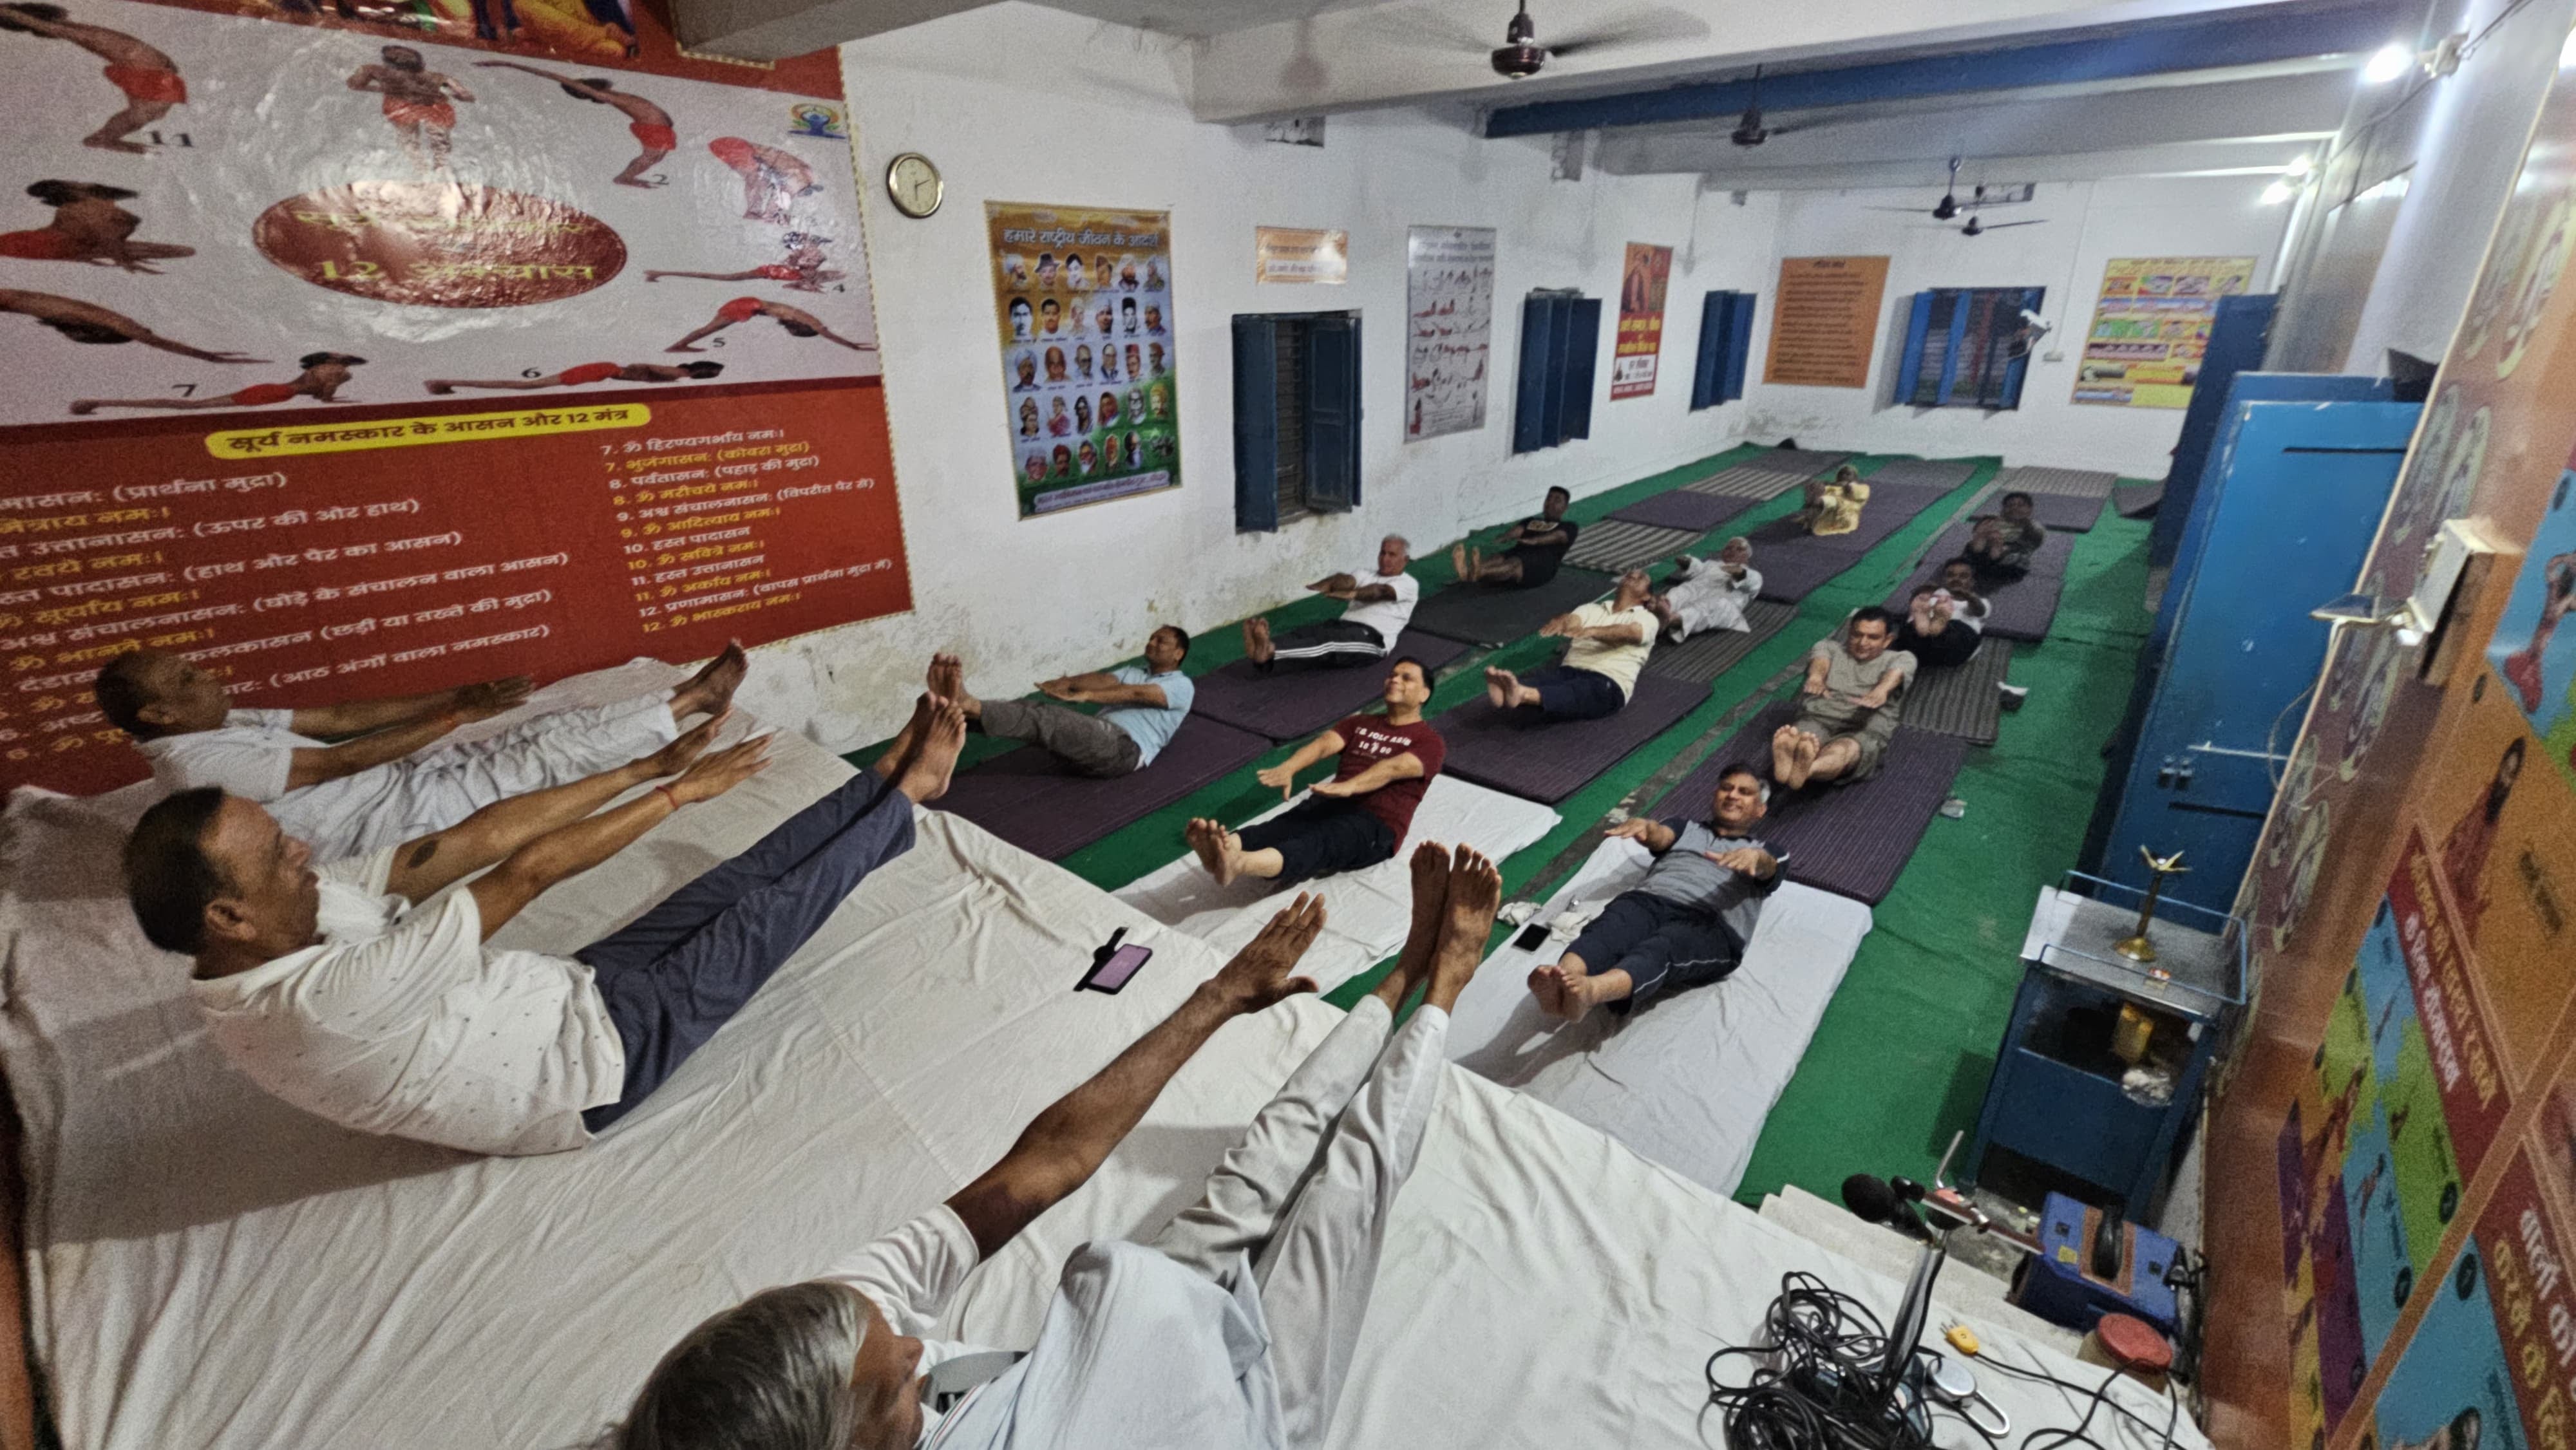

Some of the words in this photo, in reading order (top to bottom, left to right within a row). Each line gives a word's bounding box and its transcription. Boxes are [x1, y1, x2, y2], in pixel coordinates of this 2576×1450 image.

[149, 131, 194, 147] 11
[1003, 228, 1036, 243] हमारे
[1039, 227, 1076, 248] राष्ट्रीय
[1078, 229, 1111, 245] जीवन
[1113, 231, 1125, 245] के
[712, 337, 725, 348] 5
[522, 366, 541, 379] 6
[171, 383, 196, 397] 7
[227, 430, 282, 452] सूर्य
[287, 425, 405, 444] नमस्कार
[410, 421, 438, 435] के
[444, 417, 516, 433] आसन
[521, 411, 564, 427] और
[567, 412, 590, 424] 12
[593, 408, 629, 421] मंत्र
[761, 458, 782, 471] की
[273, 509, 308, 525] की
[342, 543, 377, 557] का
[384, 531, 462, 551] आसन)
[312, 587, 341, 600] के
[443, 564, 495, 580] वाला
[500, 552, 569, 572] आसन)
[381, 615, 410, 626] या
[468, 598, 500, 612] की
[392, 644, 447, 663] वाला
